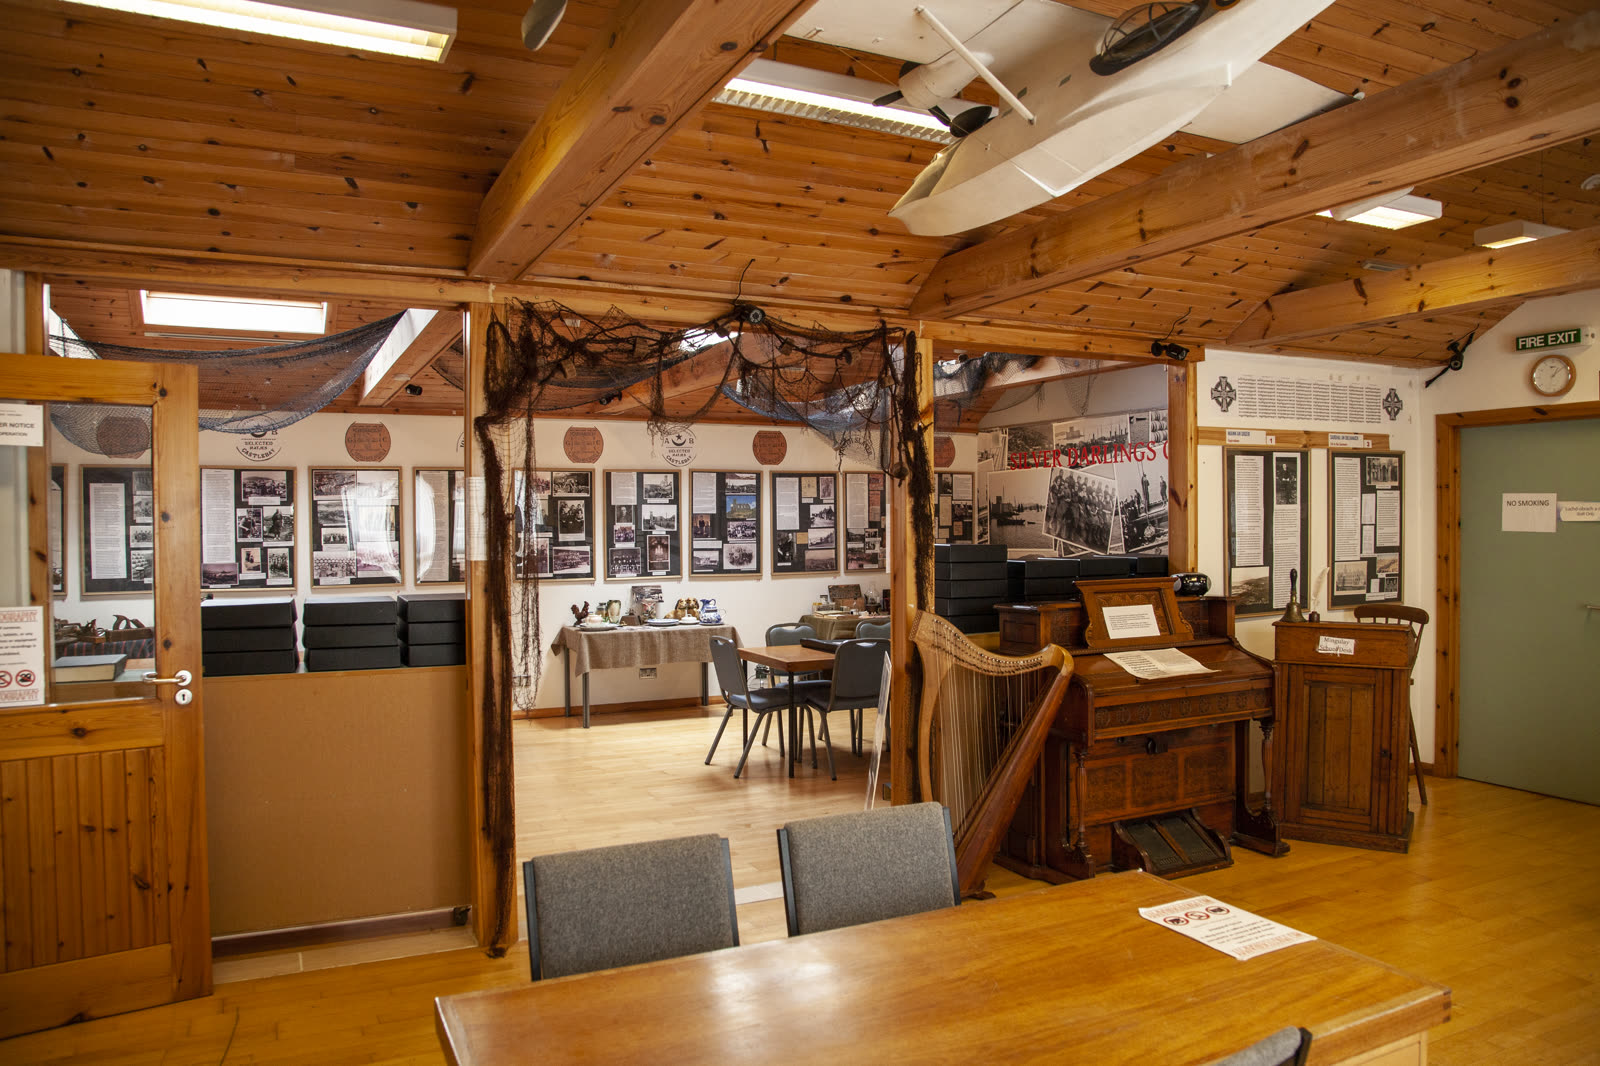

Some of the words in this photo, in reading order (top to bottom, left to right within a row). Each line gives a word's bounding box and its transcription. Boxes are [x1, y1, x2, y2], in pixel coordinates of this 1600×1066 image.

[1518, 335, 1545, 349] FIRE
[1547, 331, 1577, 345] EXIT
[241, 447, 276, 459] CASTLEBAY
[1010, 449, 1062, 471] SILVER
[1067, 440, 1157, 467] DARLINGS
[666, 455, 692, 465] CASTLEBAY
[1324, 636, 1349, 646] Mingulay
